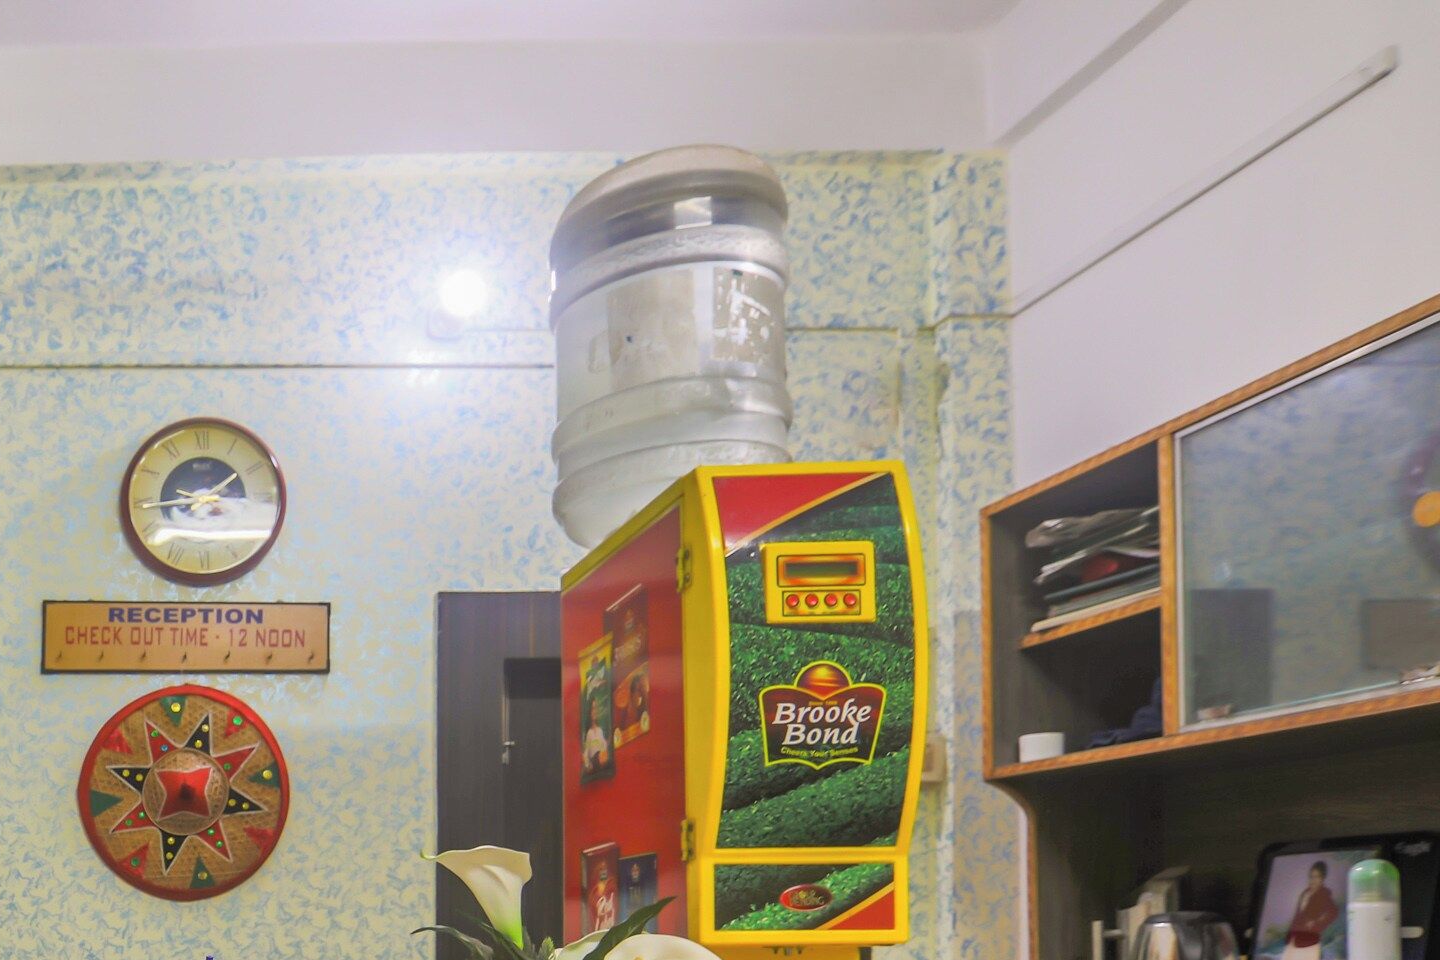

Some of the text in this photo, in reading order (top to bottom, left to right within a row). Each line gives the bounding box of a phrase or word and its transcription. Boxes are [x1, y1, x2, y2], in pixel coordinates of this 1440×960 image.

[108, 607, 264, 625] RECEPTION
[65, 626, 305, 648] CHECK OUT TIME 12 NOON
[772, 698, 872, 725] Brooke
[781, 722, 860, 745] Bond
